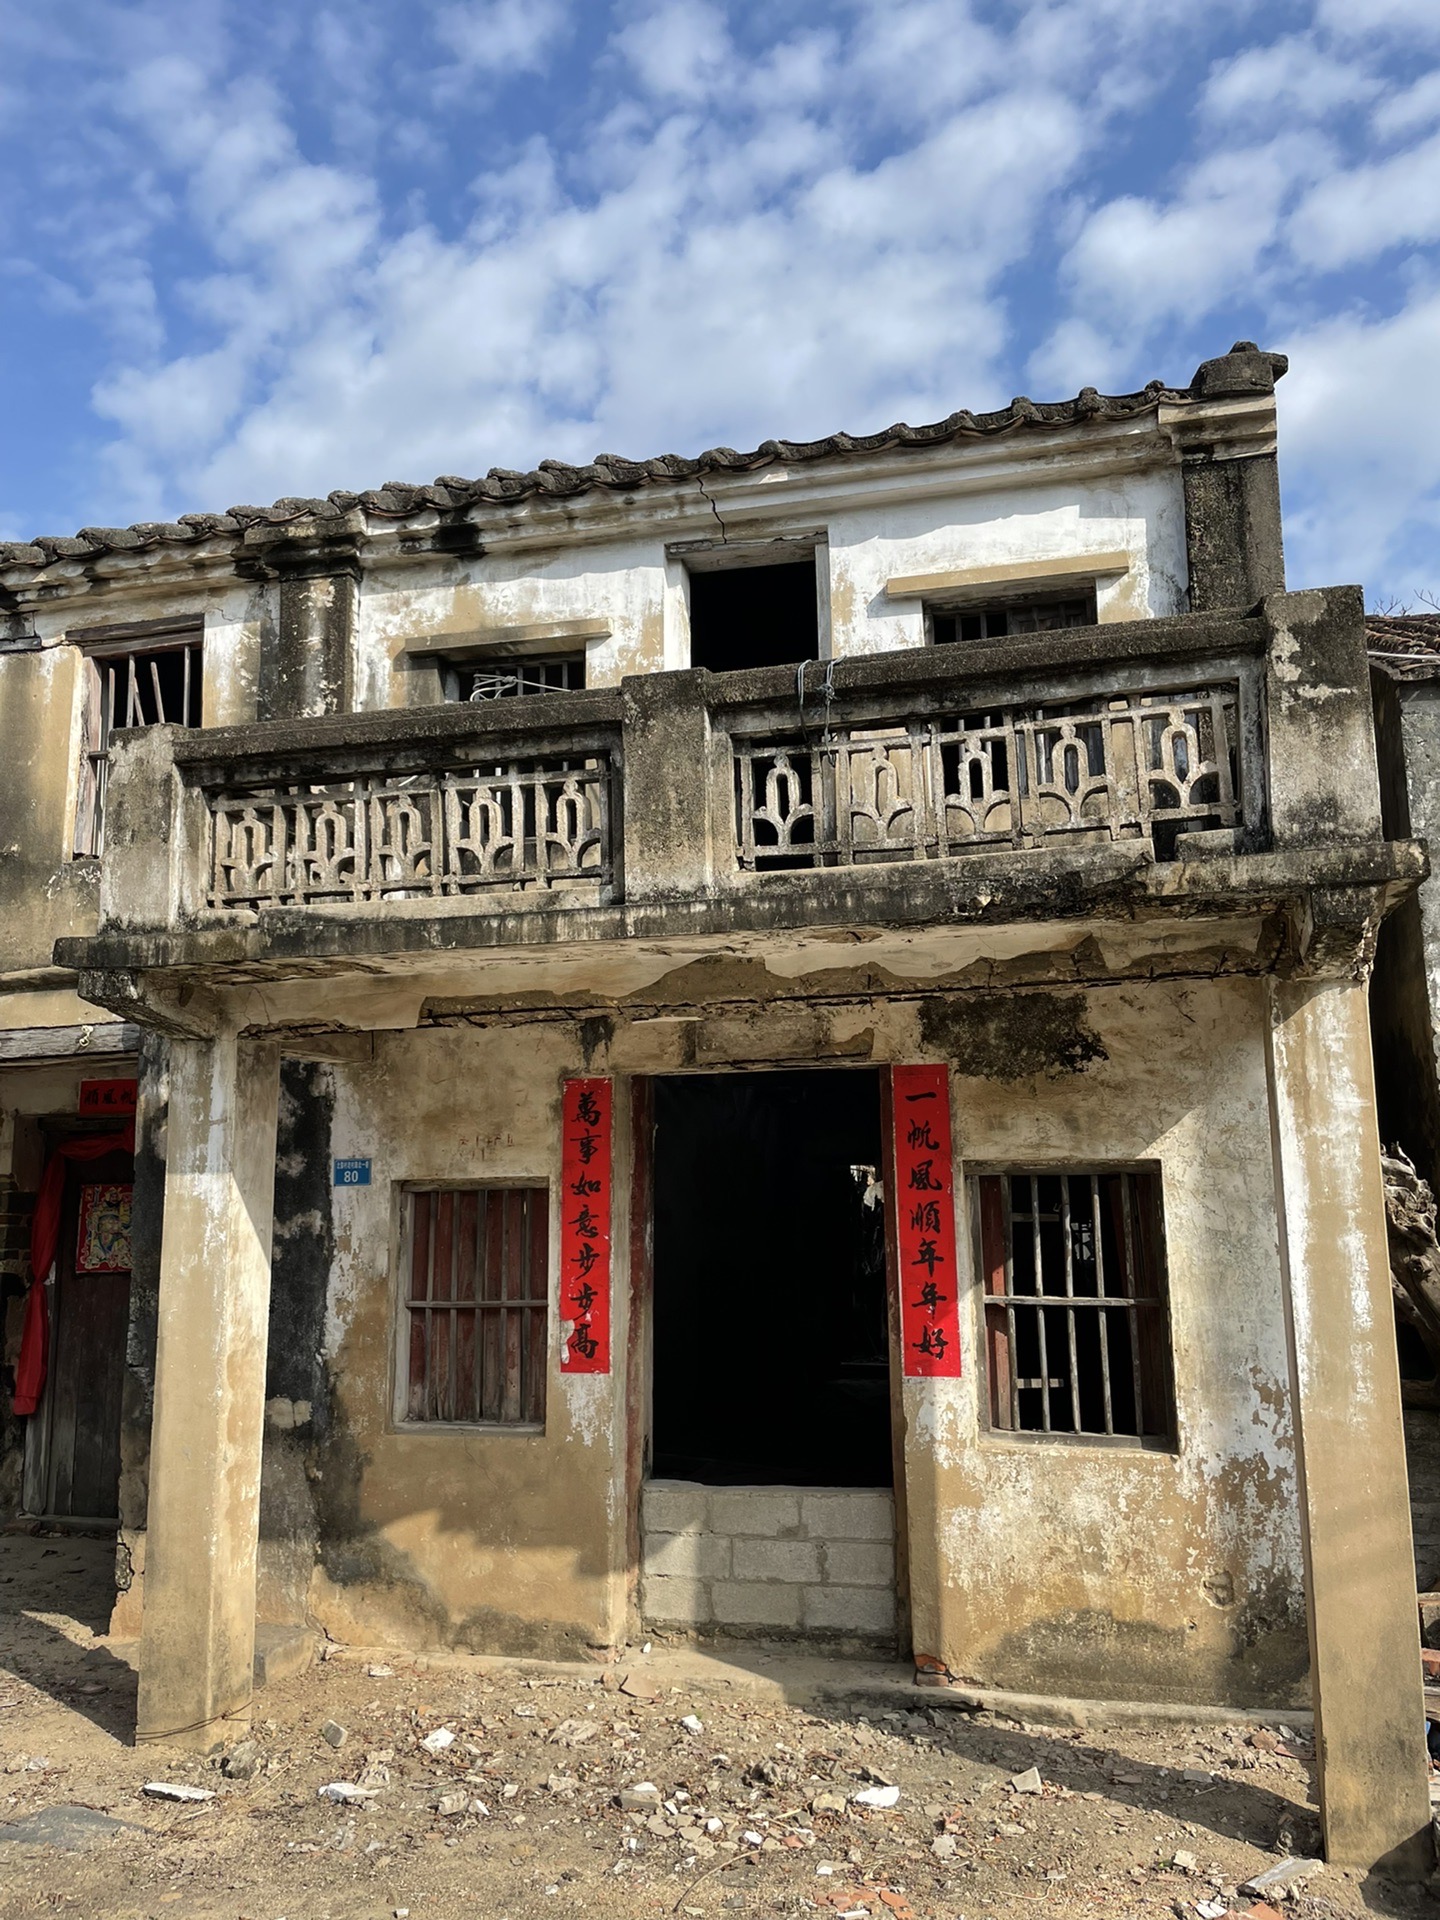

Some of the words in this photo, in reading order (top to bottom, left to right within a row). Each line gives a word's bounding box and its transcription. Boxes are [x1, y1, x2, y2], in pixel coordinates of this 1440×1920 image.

[344, 1170, 359, 1183] 80
[905, 1091, 948, 1361] 一帆風順年年好
